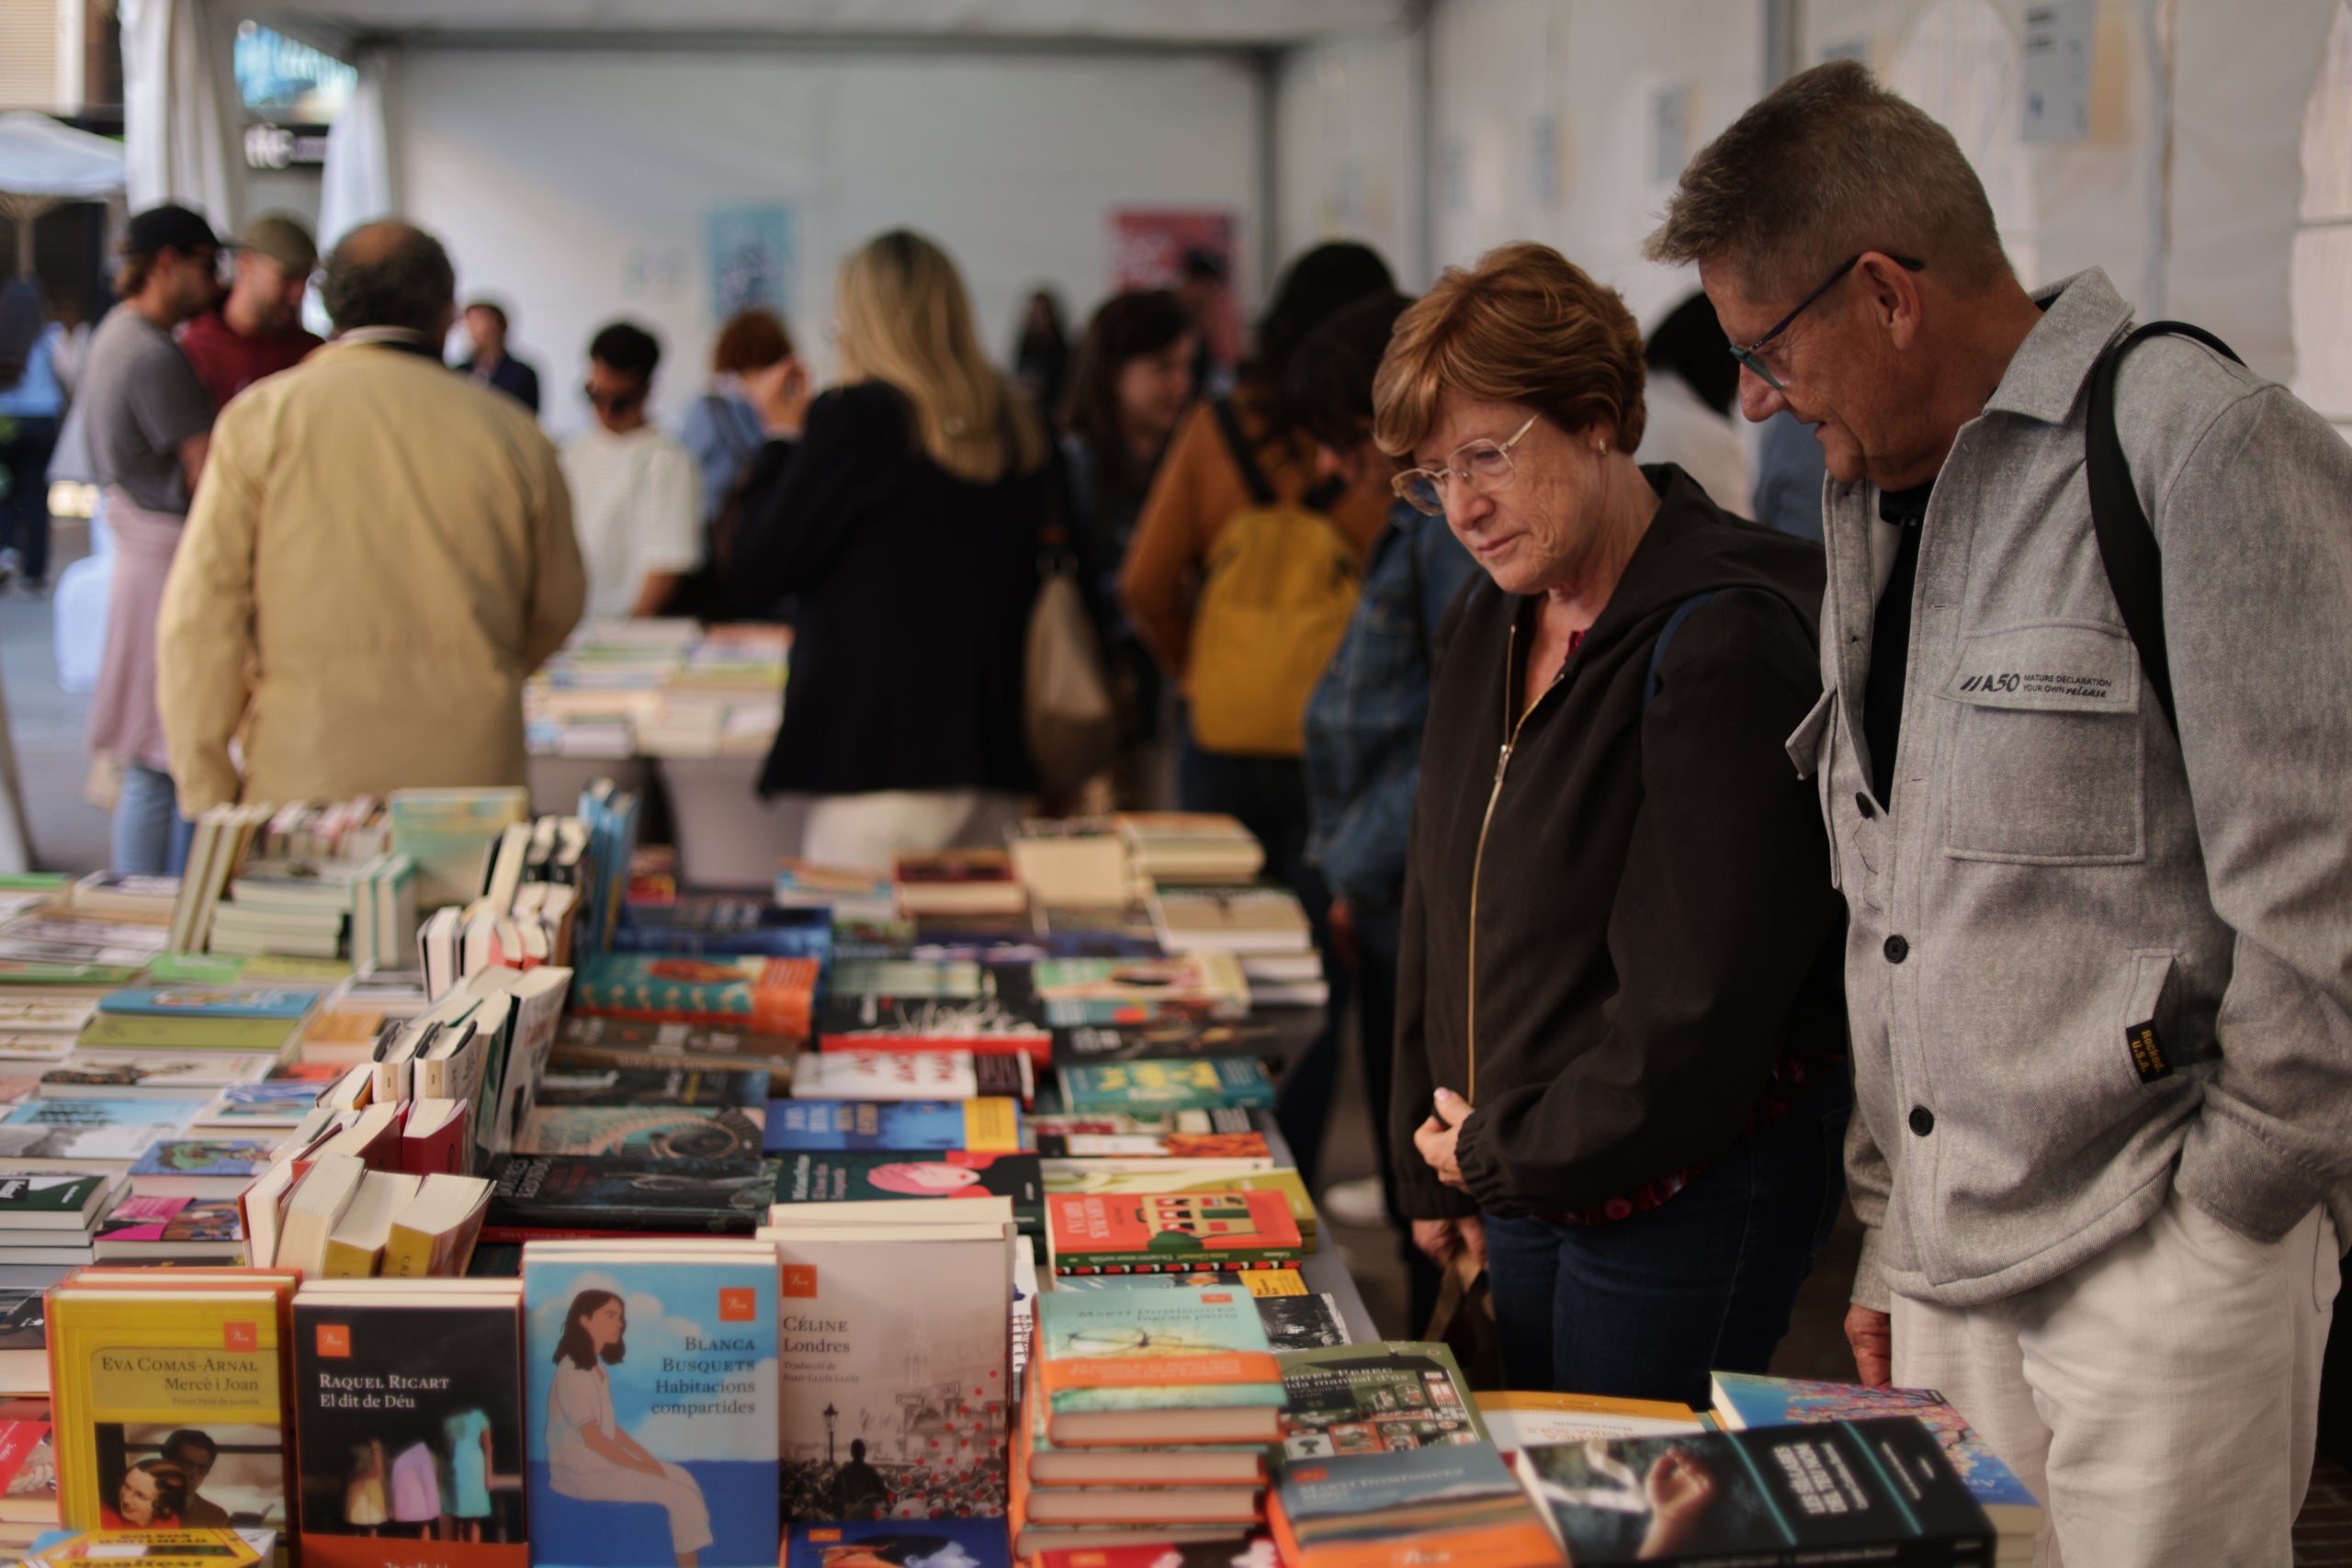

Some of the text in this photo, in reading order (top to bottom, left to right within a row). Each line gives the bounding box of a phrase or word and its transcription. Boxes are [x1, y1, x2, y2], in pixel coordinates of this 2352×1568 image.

[2024, 674, 2112, 687] MATURE DECLARATION
[2044, 685, 2066, 694] OWN
[783, 1315, 848, 1333] CÉLINE
[684, 1337, 755, 1351] BLANCA
[784, 1338, 851, 1353] Londres
[102, 1357, 258, 1372] EVA COMAS-ARNAL
[662, 1358, 755, 1374] BUSQUETS
[165, 1378, 259, 1393] Mercè i Joan
[319, 1373, 449, 1391] RAQUEL RICART
[656, 1379, 755, 1394] Habitacions
[321, 1393, 415, 1408] El dit de Déu
[651, 1399, 755, 1418] compartides
